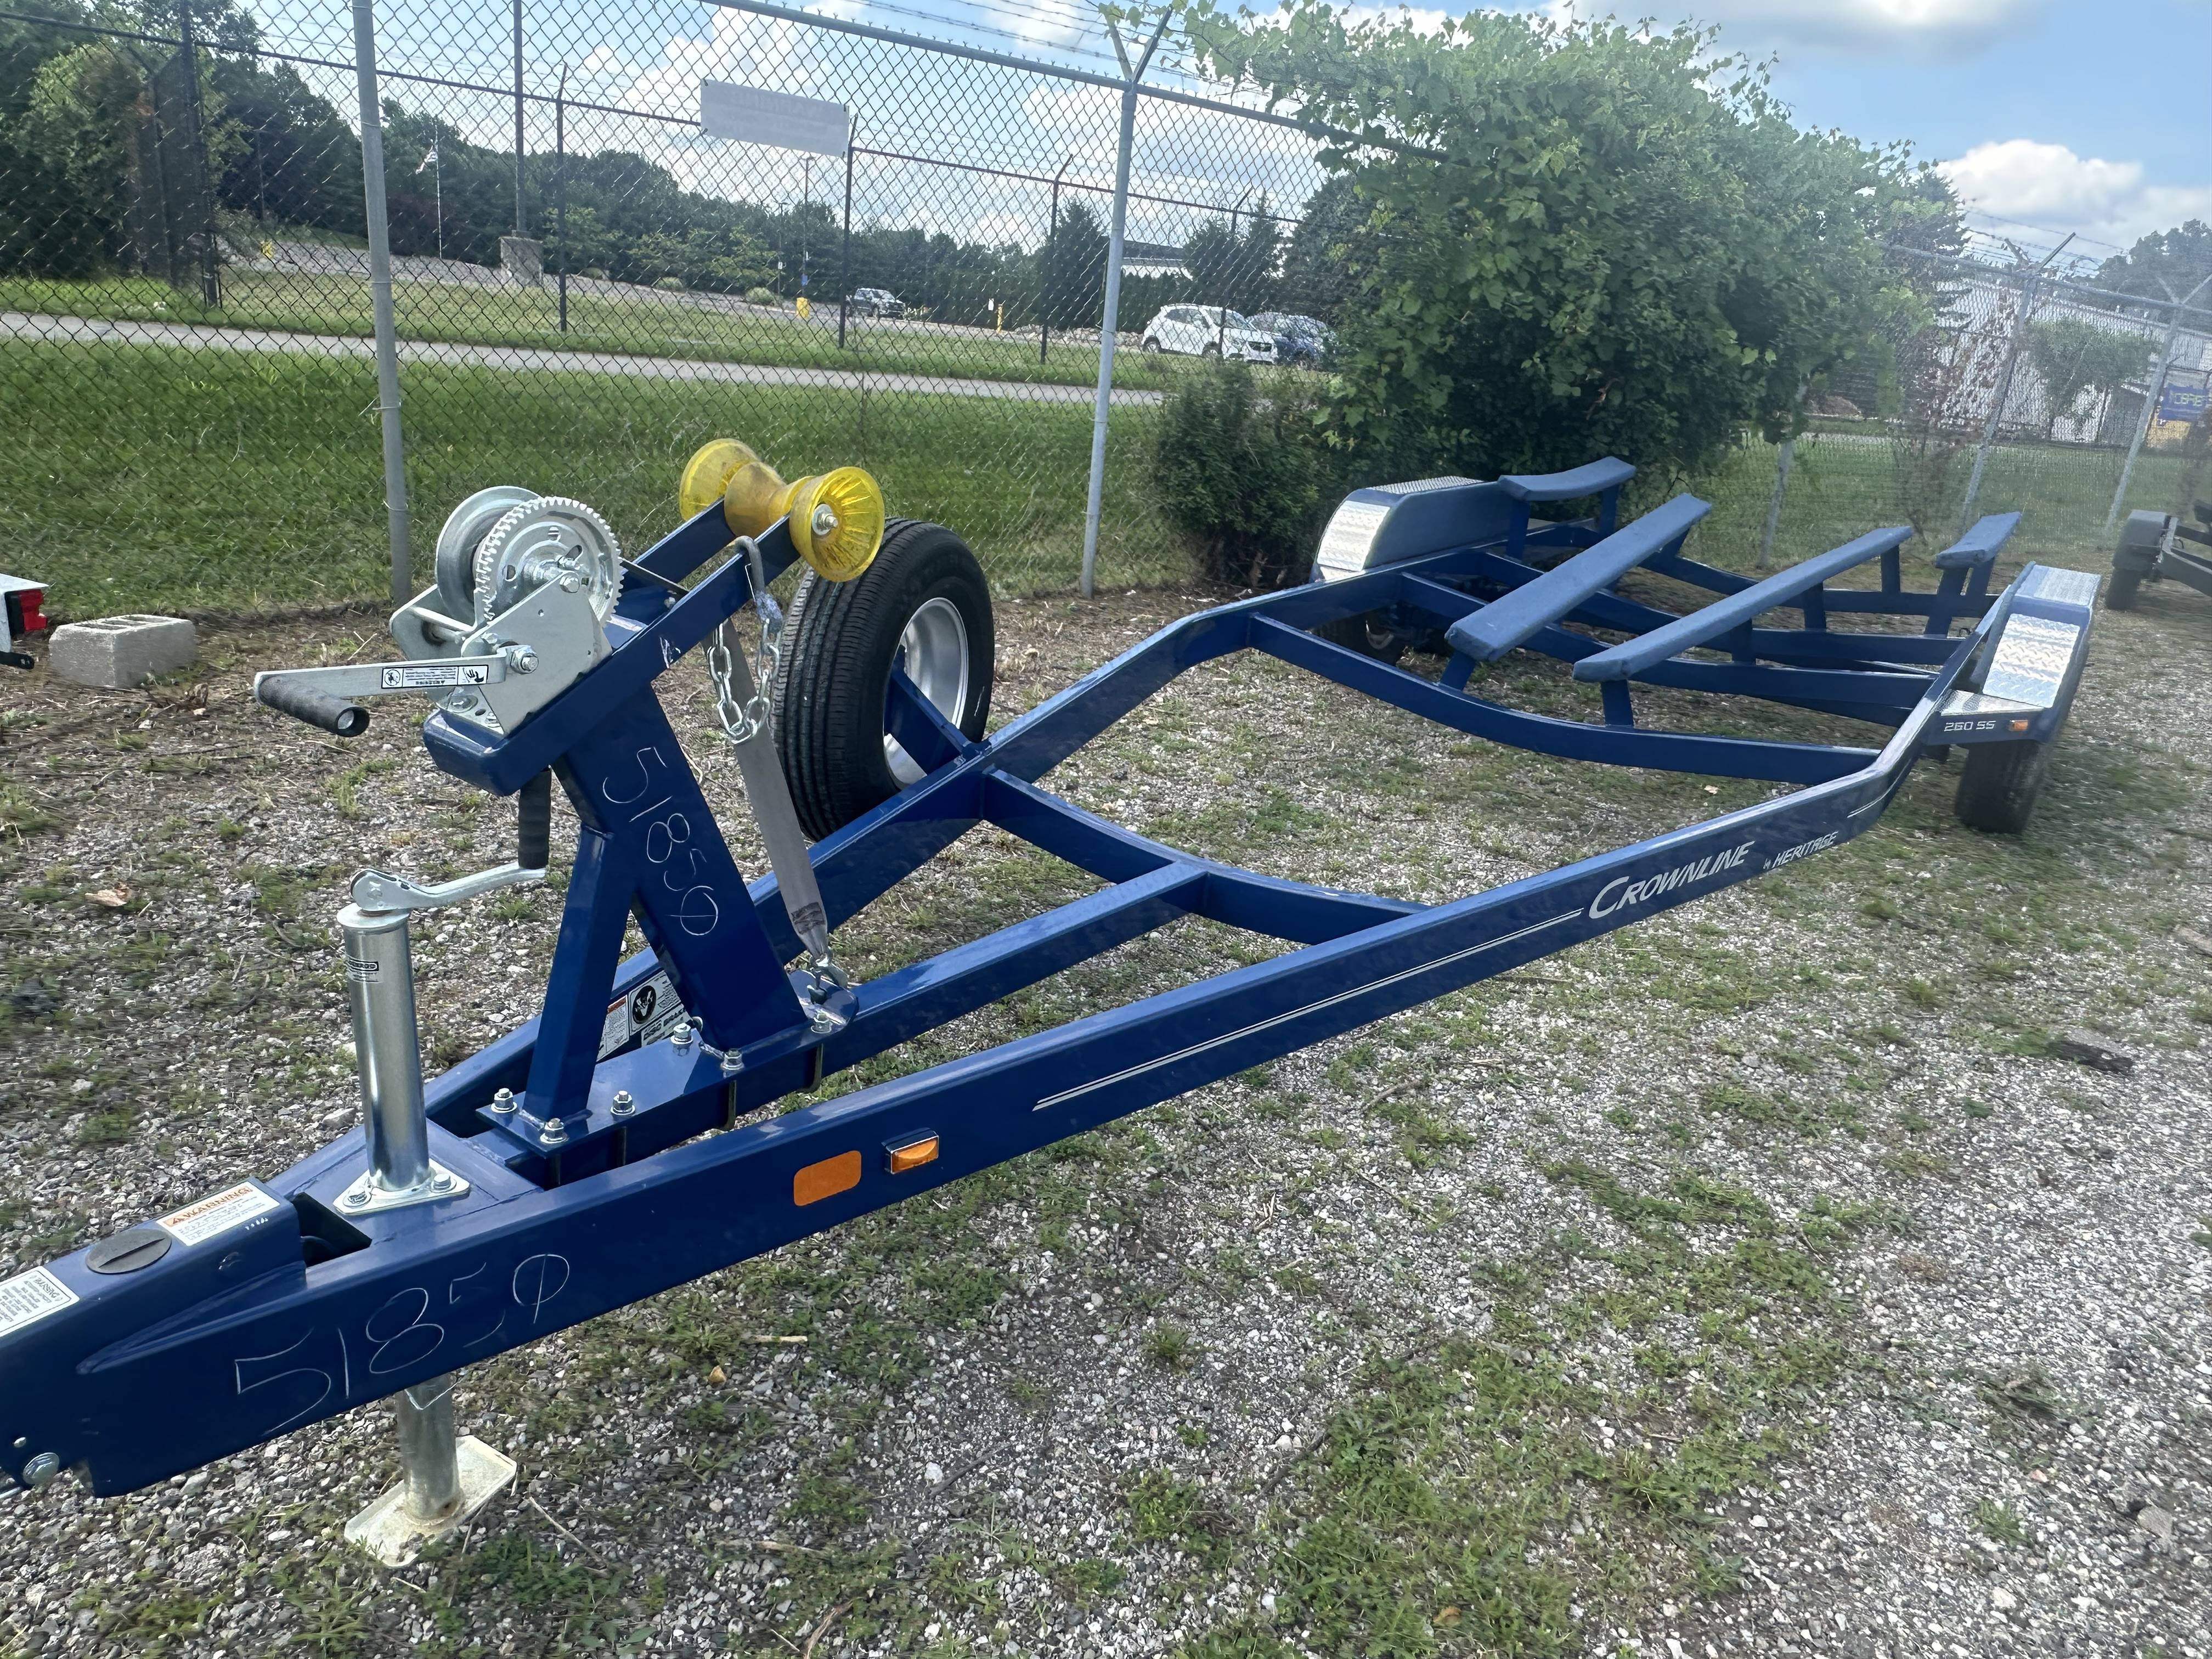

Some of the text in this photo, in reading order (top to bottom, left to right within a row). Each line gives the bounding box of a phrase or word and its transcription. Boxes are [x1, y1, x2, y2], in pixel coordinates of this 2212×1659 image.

[1944, 720, 1997, 732] 260 SS
[1588, 840, 1756, 919] CROWNLINE
[1771, 831, 1839, 869] HERITAGE
